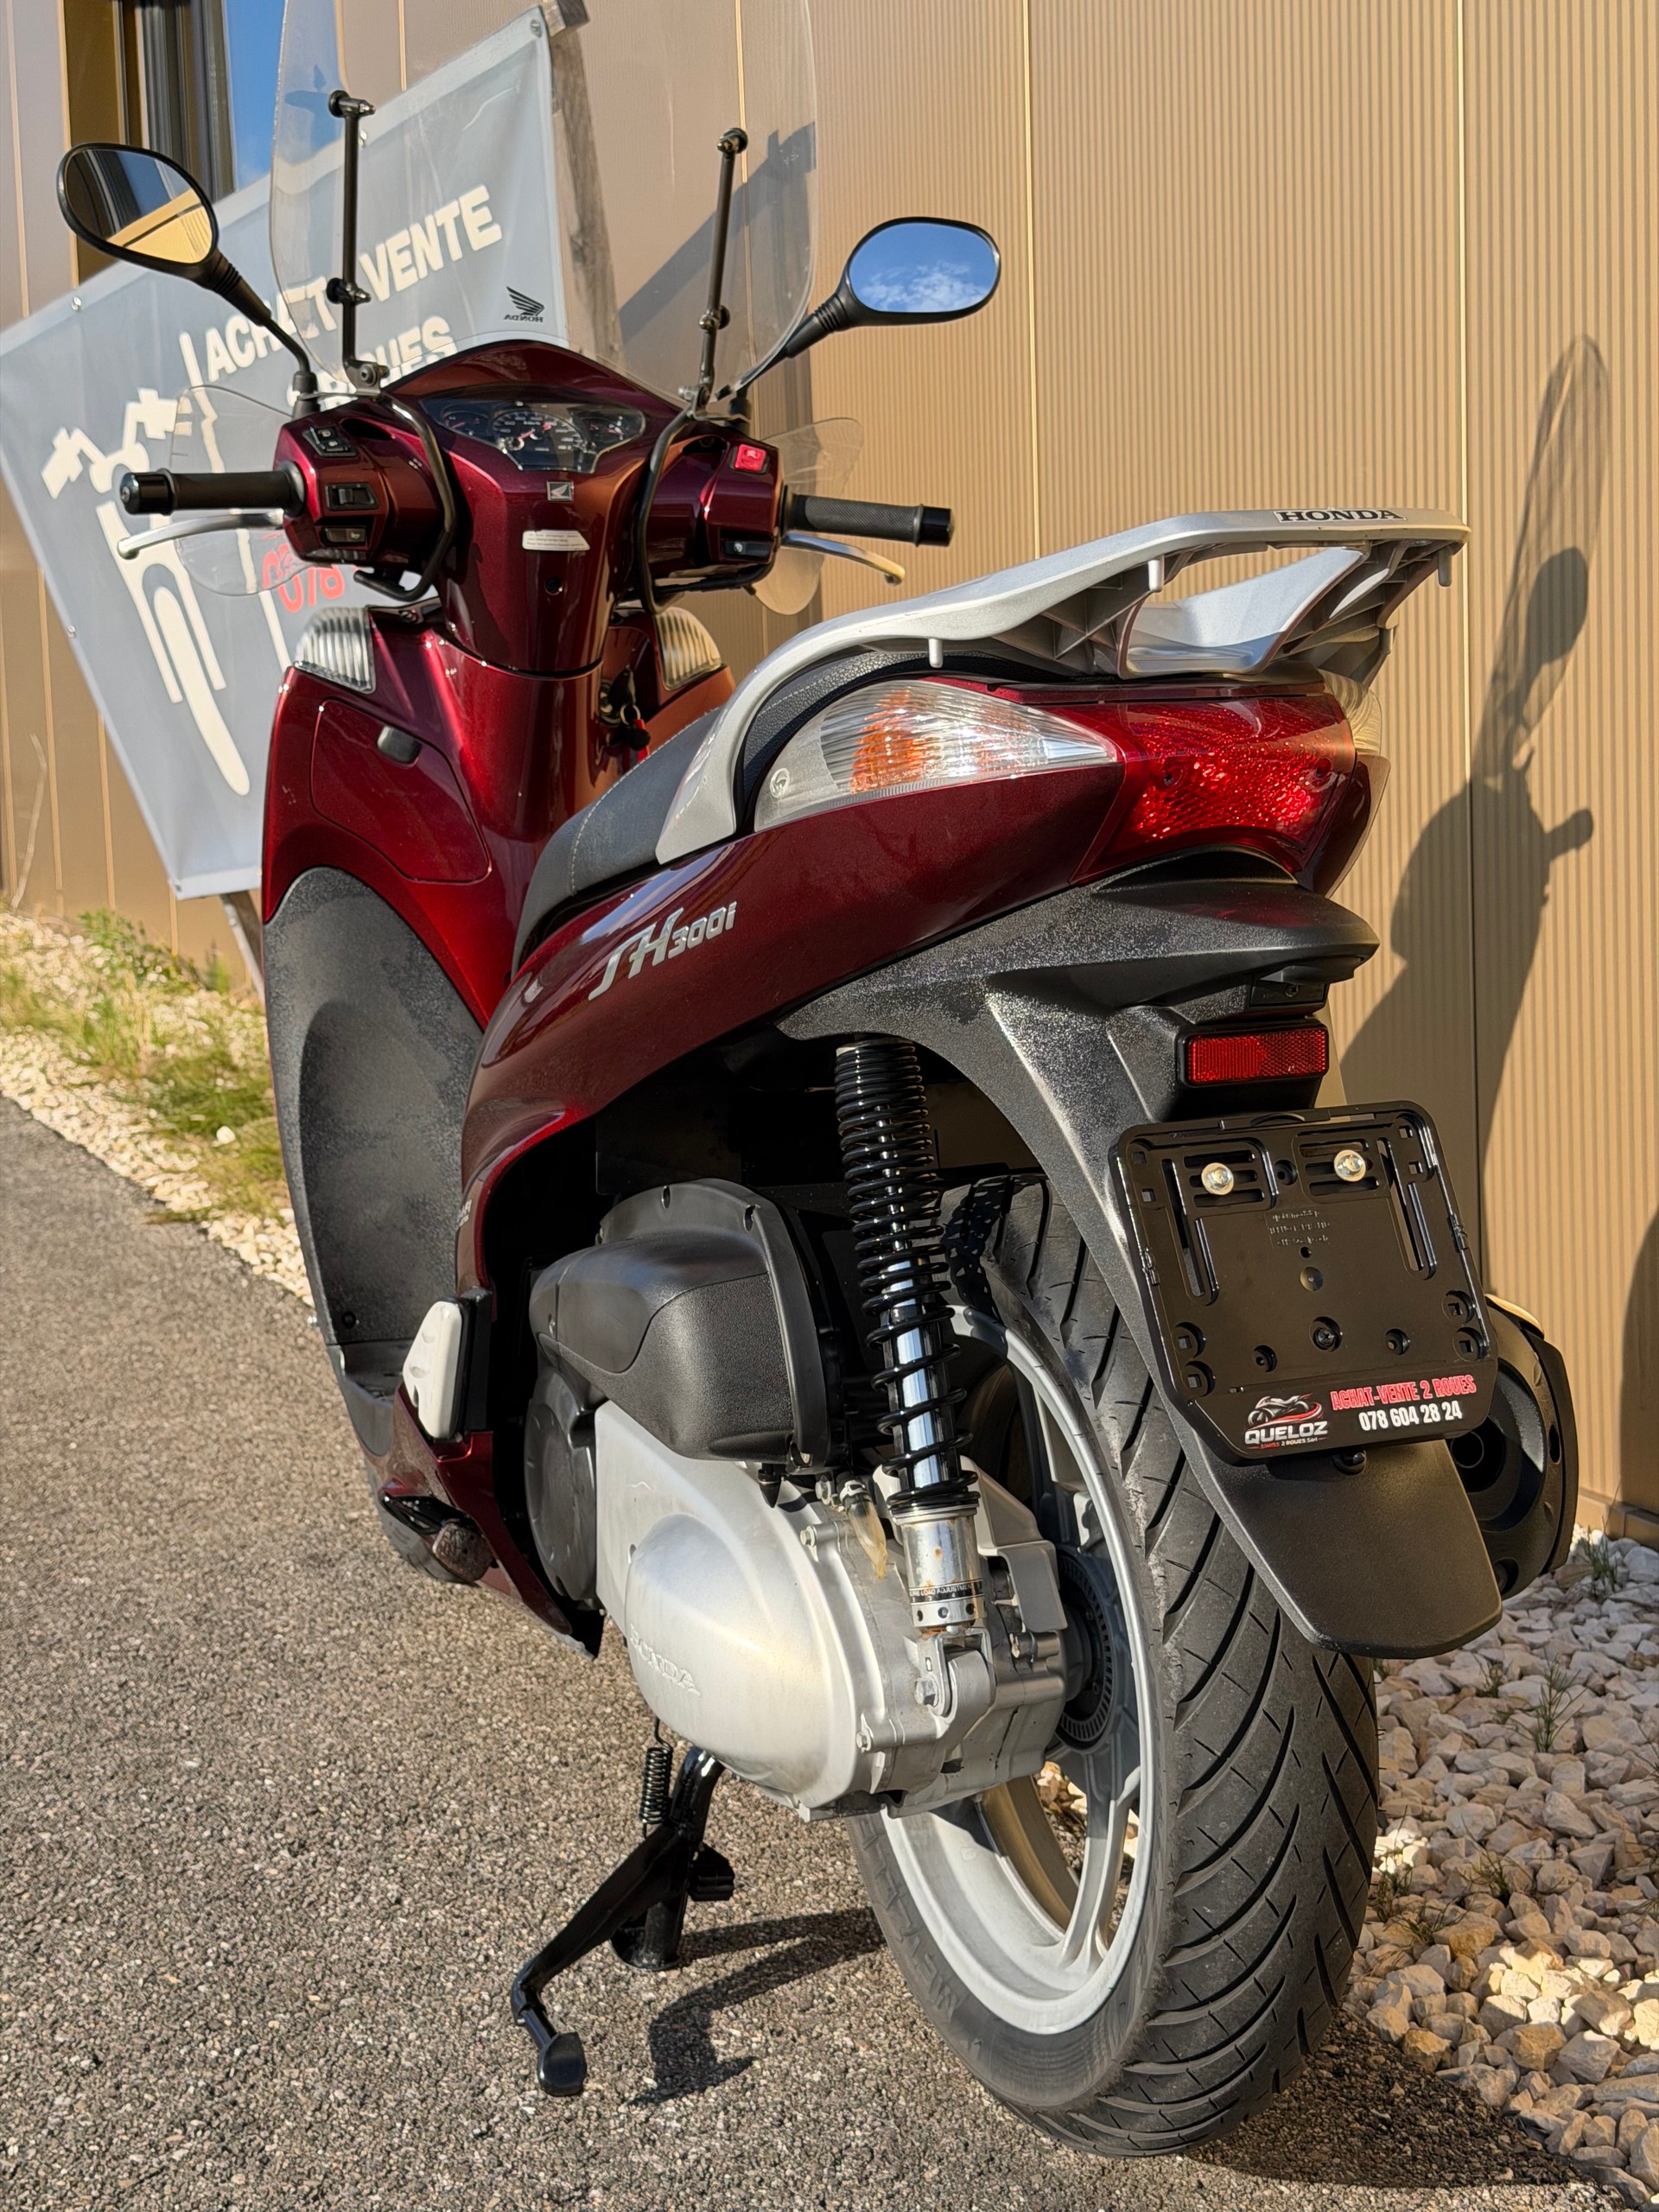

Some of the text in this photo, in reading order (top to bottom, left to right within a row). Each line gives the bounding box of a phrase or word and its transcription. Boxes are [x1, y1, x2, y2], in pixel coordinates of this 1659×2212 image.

[359, 185, 502, 302] VENTE
[1277, 510, 1405, 522] HONDA
[588, 900, 737, 1001] SH300i
[1330, 1374, 1477, 1410] ACHAT-VENTE 2 ROUES
[1358, 1400, 1463, 1431] 078 604 28 24
[1244, 1421, 1328, 1445] QUELOZ
